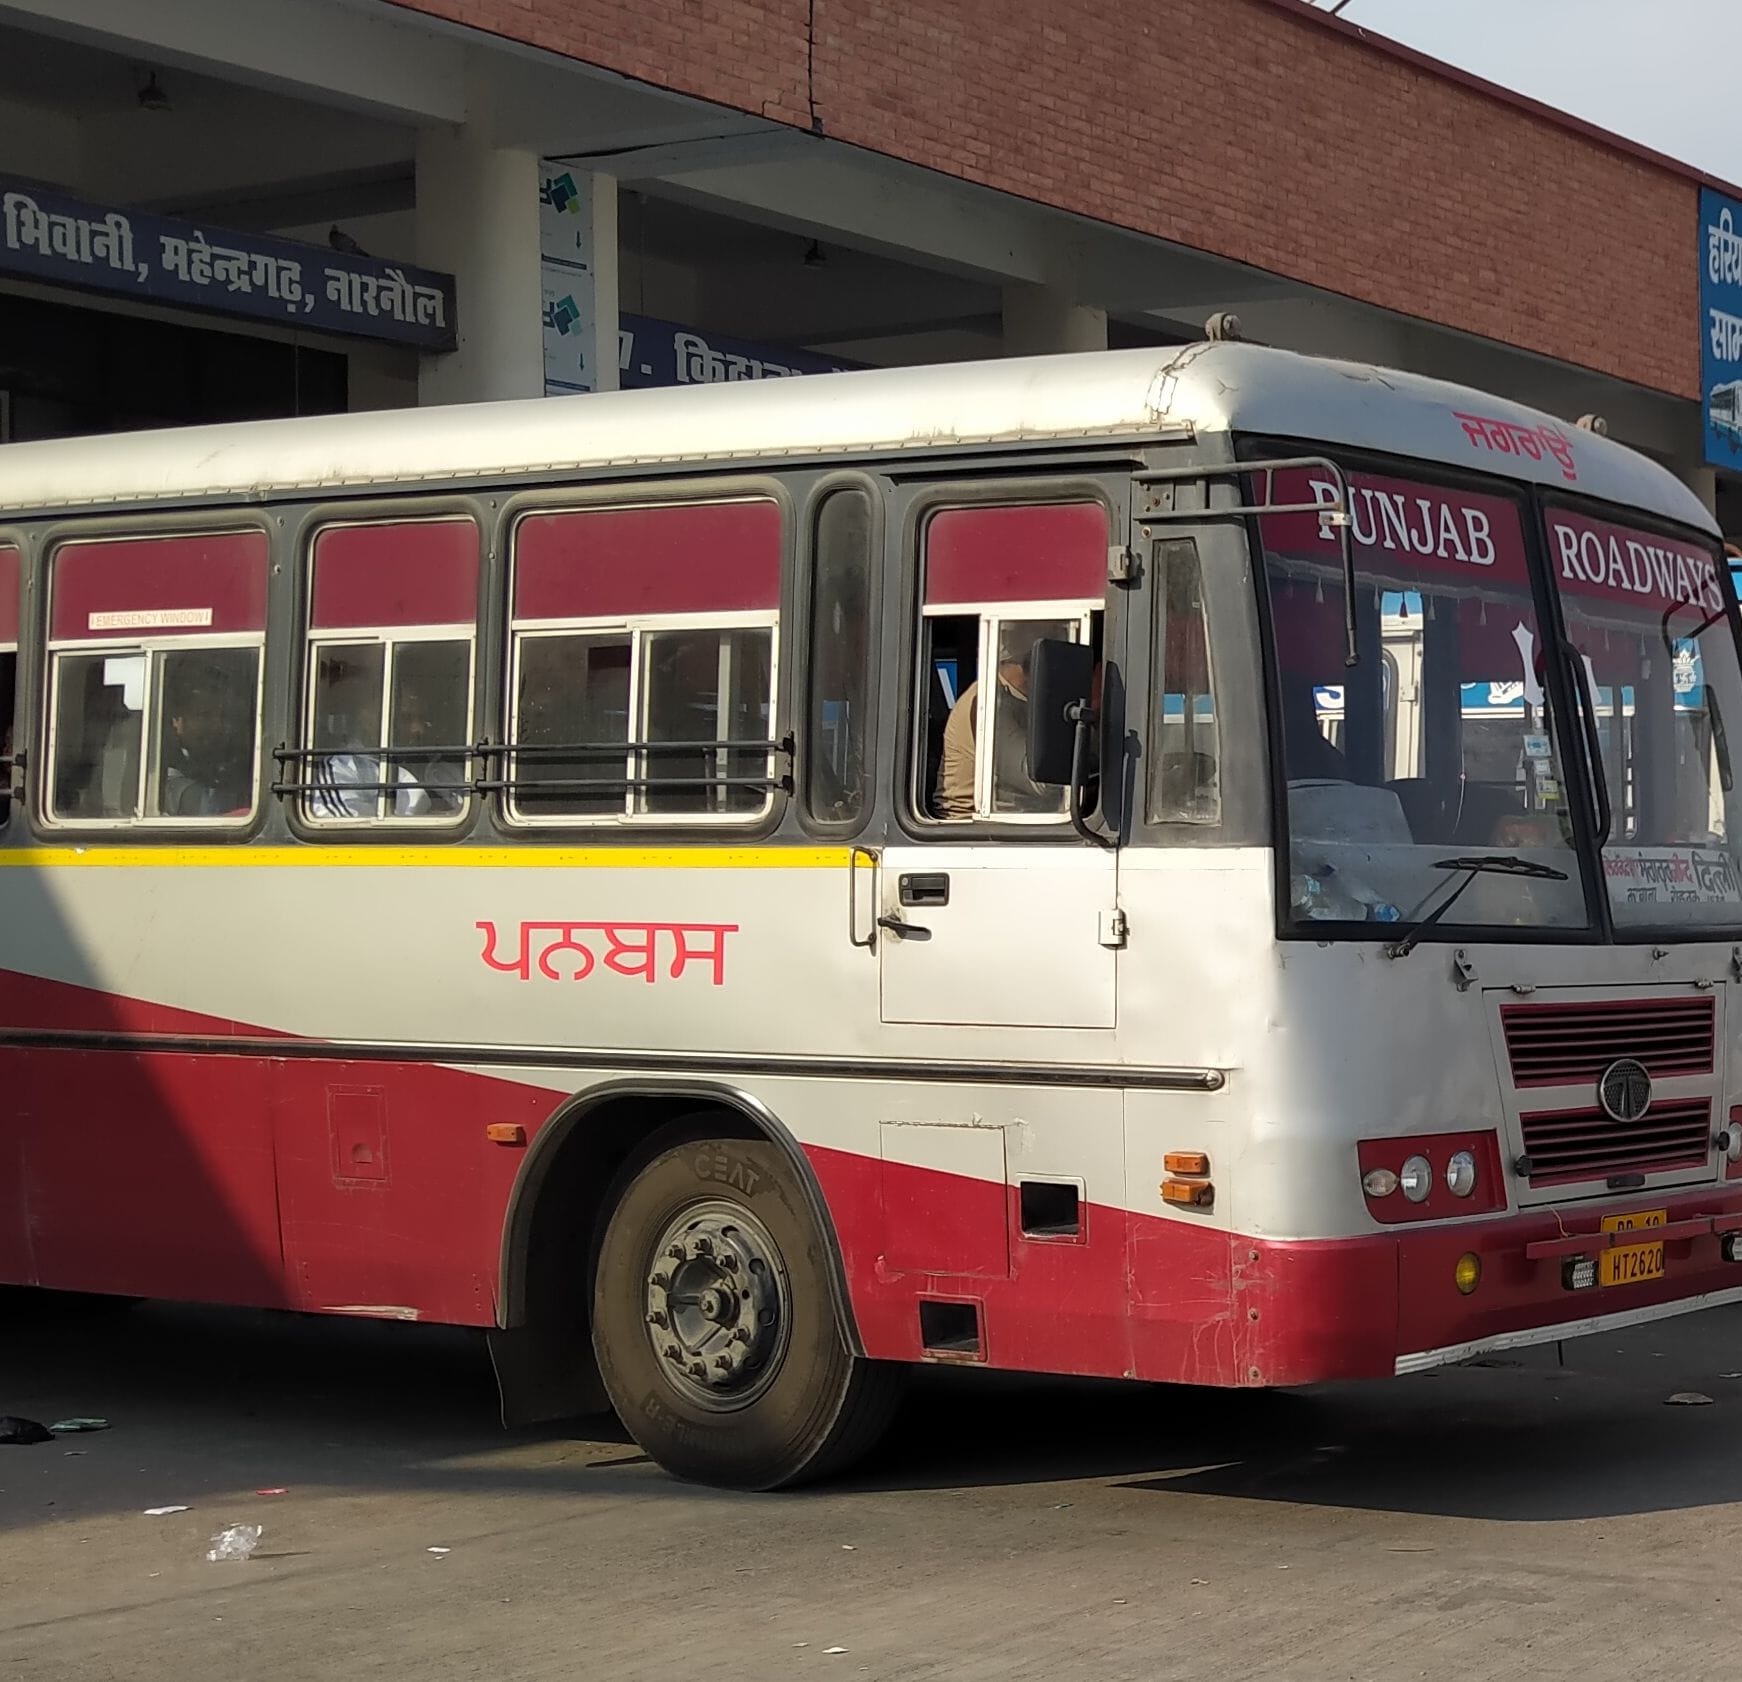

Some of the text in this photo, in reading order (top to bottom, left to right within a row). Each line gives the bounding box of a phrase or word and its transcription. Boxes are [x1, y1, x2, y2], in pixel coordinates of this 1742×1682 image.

[3, 191, 149, 282] भिवानी,
[324, 268, 446, 327] नारनौल
[1308, 478, 1724, 613] PUNJAB ROADWAYS
[476, 921, 740, 986] ਪਨਬਸ
[694, 1154, 760, 1194] CEAT
[1613, 1247, 1662, 1281] HT2620
